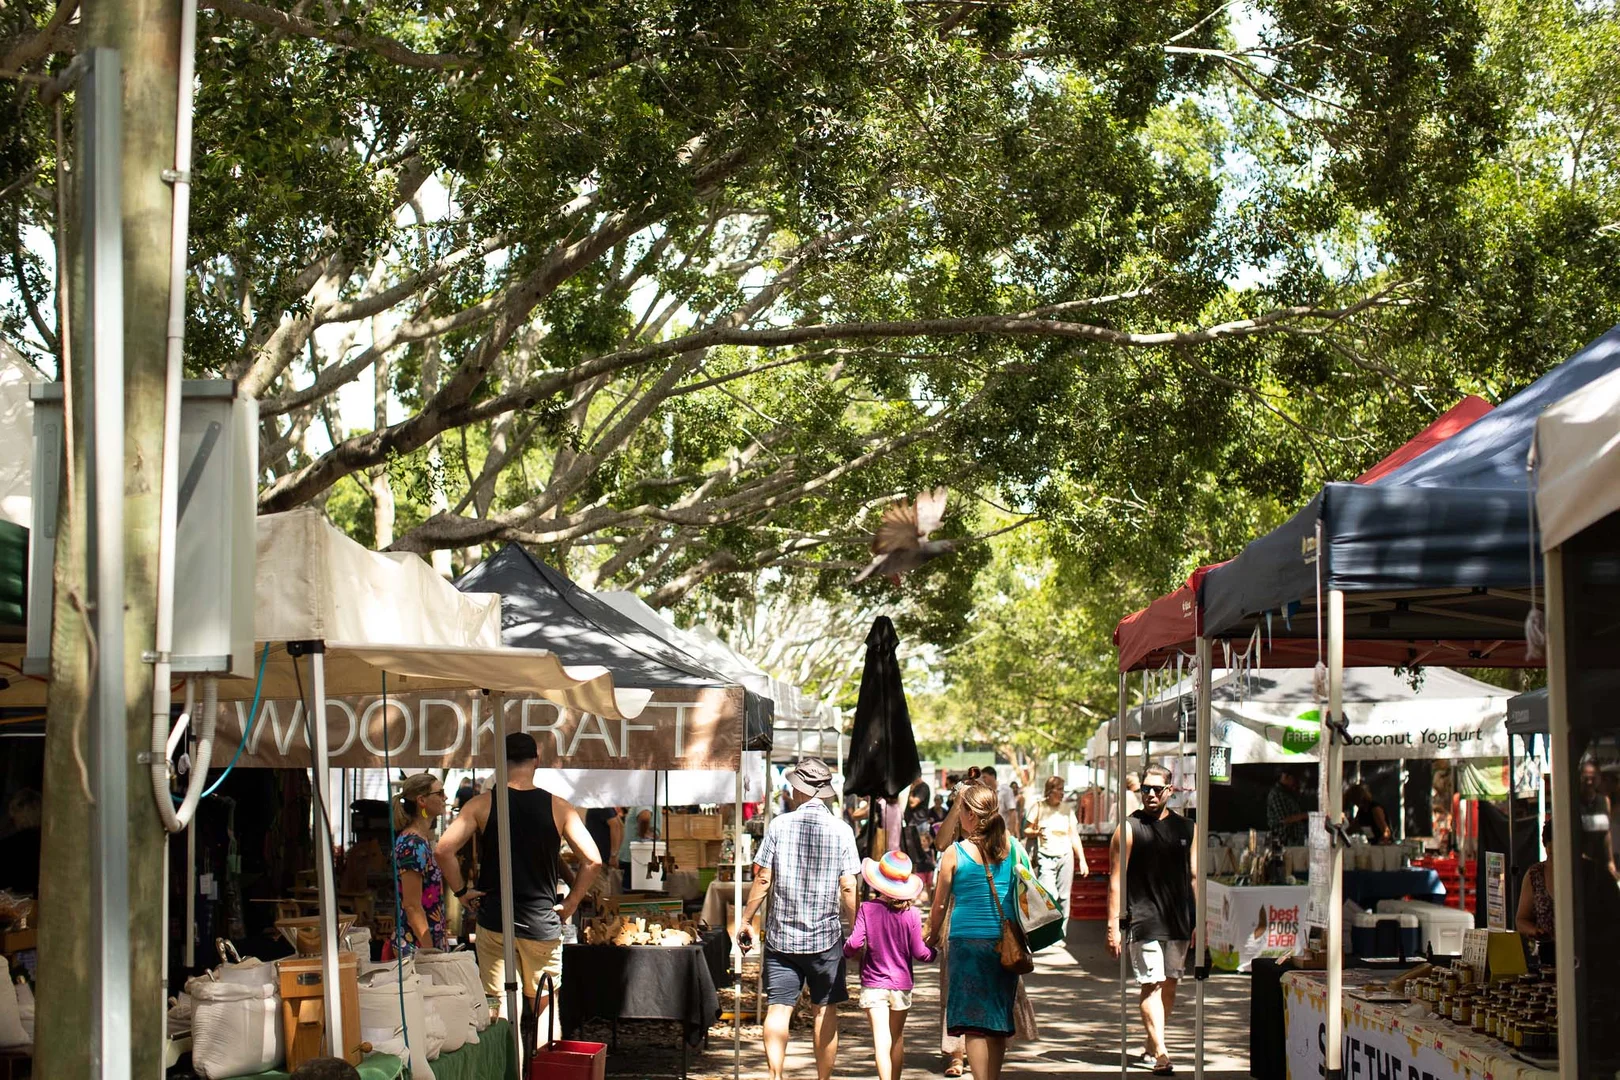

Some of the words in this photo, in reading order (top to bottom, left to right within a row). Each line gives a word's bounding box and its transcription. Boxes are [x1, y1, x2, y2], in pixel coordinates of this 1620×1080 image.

[235, 699, 704, 757] WOODKRAFT
[1286, 731, 1316, 743] FREE
[1420, 726, 1483, 749] Yoghurt
[1269, 905, 1299, 921] best
[1268, 921, 1299, 935] POOS
[1267, 935, 1296, 947] EVER!
[1318, 1022, 1361, 1080] SVE
